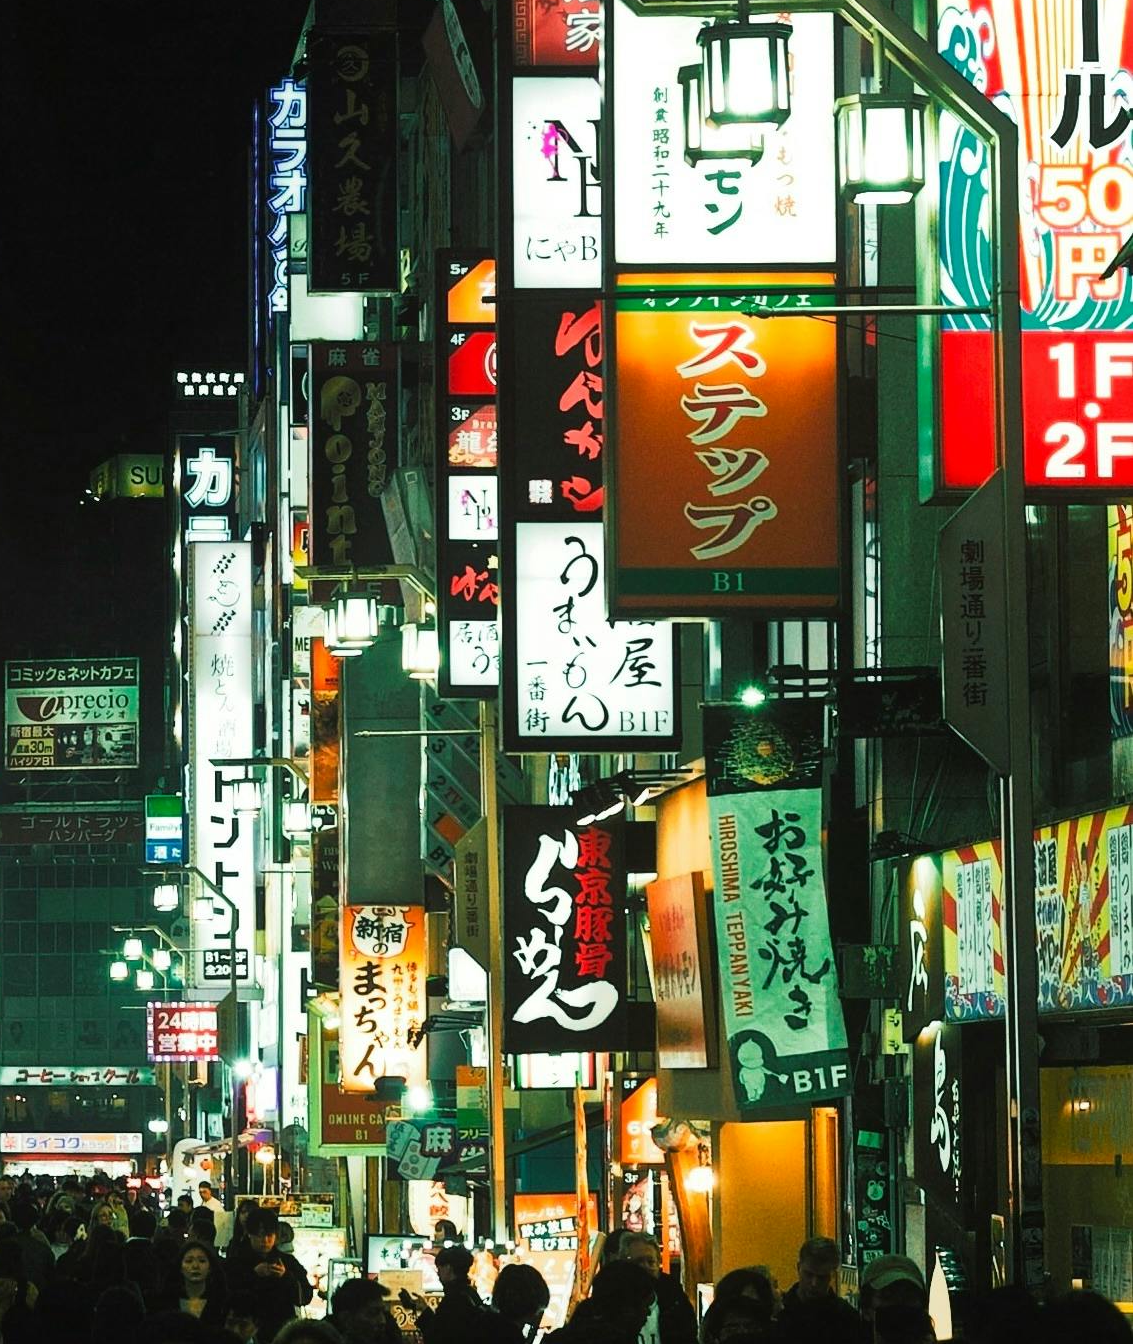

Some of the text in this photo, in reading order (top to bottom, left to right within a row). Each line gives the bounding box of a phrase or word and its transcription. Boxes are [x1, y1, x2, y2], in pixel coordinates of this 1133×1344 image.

[651, 86, 672, 240] 創業昭和二十九年
[341, 272, 371, 285] 5F
[450, 264, 469, 275] 5F
[1053, 231, 1124, 303] 円
[450, 334, 466, 346] 4F
[327, 348, 382, 367] 麻雀
[1048, 341, 1133, 400] 1F
[451, 407, 471, 421] 3F
[674, 318, 779, 562] ステップ
[1043, 421, 1133, 479] 2F
[130, 465, 164, 486] SU
[712, 571, 746, 592] B1
[959, 538, 989, 708] 劇場通り一番街
[10, 665, 135, 682] コミック&ネットカフェ
[39, 688, 129, 720] aprecio
[524, 659, 551, 734] 一番街
[618, 709, 670, 734] B1F
[48, 828, 117, 843] ハンバーグ
[573, 826, 614, 980] 東京豚骨
[717, 814, 754, 1018] HIROSHIMA TEPPANYAKI
[355, 915, 405, 945] 新宿
[749, 808, 832, 1034] お好み焼き
[157, 1012, 218, 1031] 24時間
[157, 1032, 218, 1055] 営業中
[792, 1063, 849, 1096] B1F
[368, 1113, 384, 1126] CA
